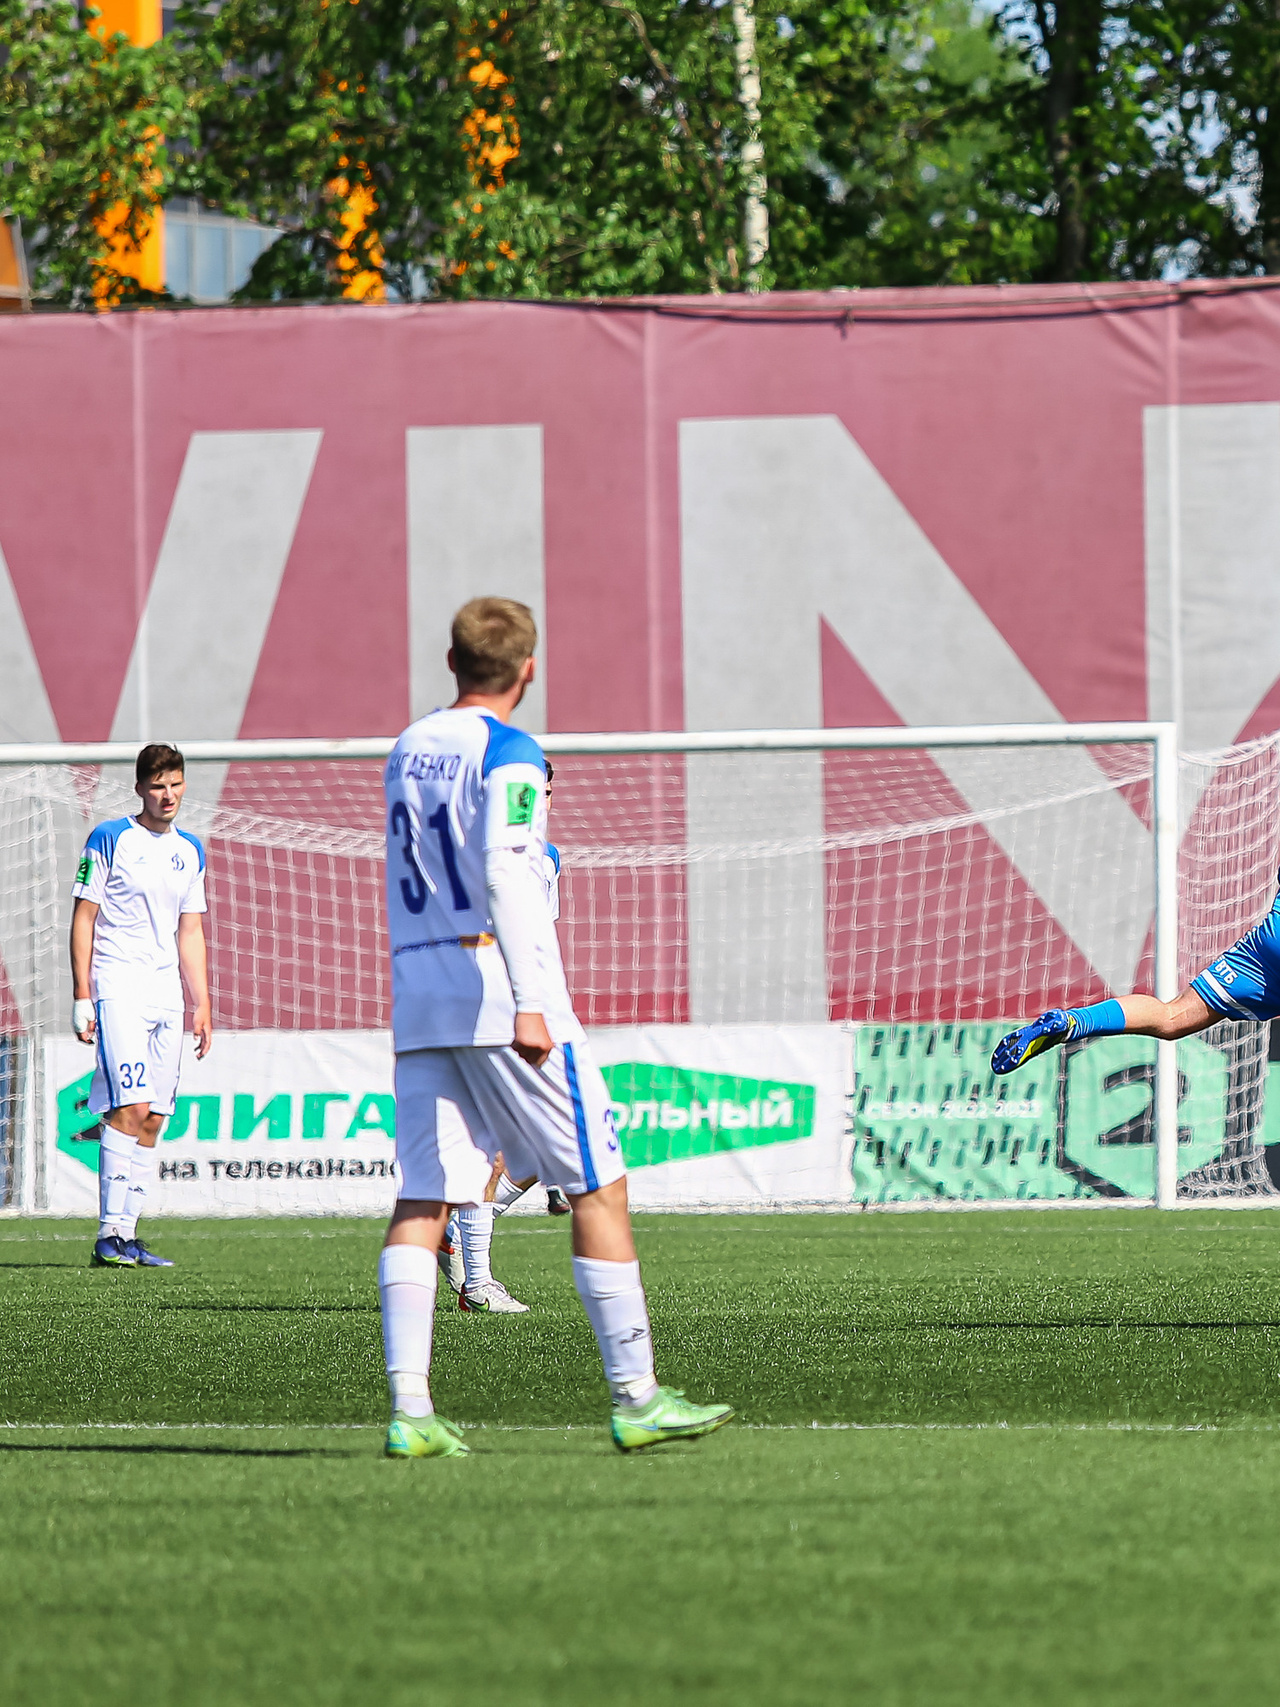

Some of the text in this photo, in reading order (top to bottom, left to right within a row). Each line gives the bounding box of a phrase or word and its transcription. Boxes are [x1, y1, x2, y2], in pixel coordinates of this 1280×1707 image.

[391, 801, 472, 915] 31
[1214, 958, 1239, 985] ВТБ
[119, 1061, 147, 1090] 32
[162, 1091, 396, 1142] ЛИГА
[611, 1088, 796, 1131] ольный
[158, 1158, 198, 1182] на
